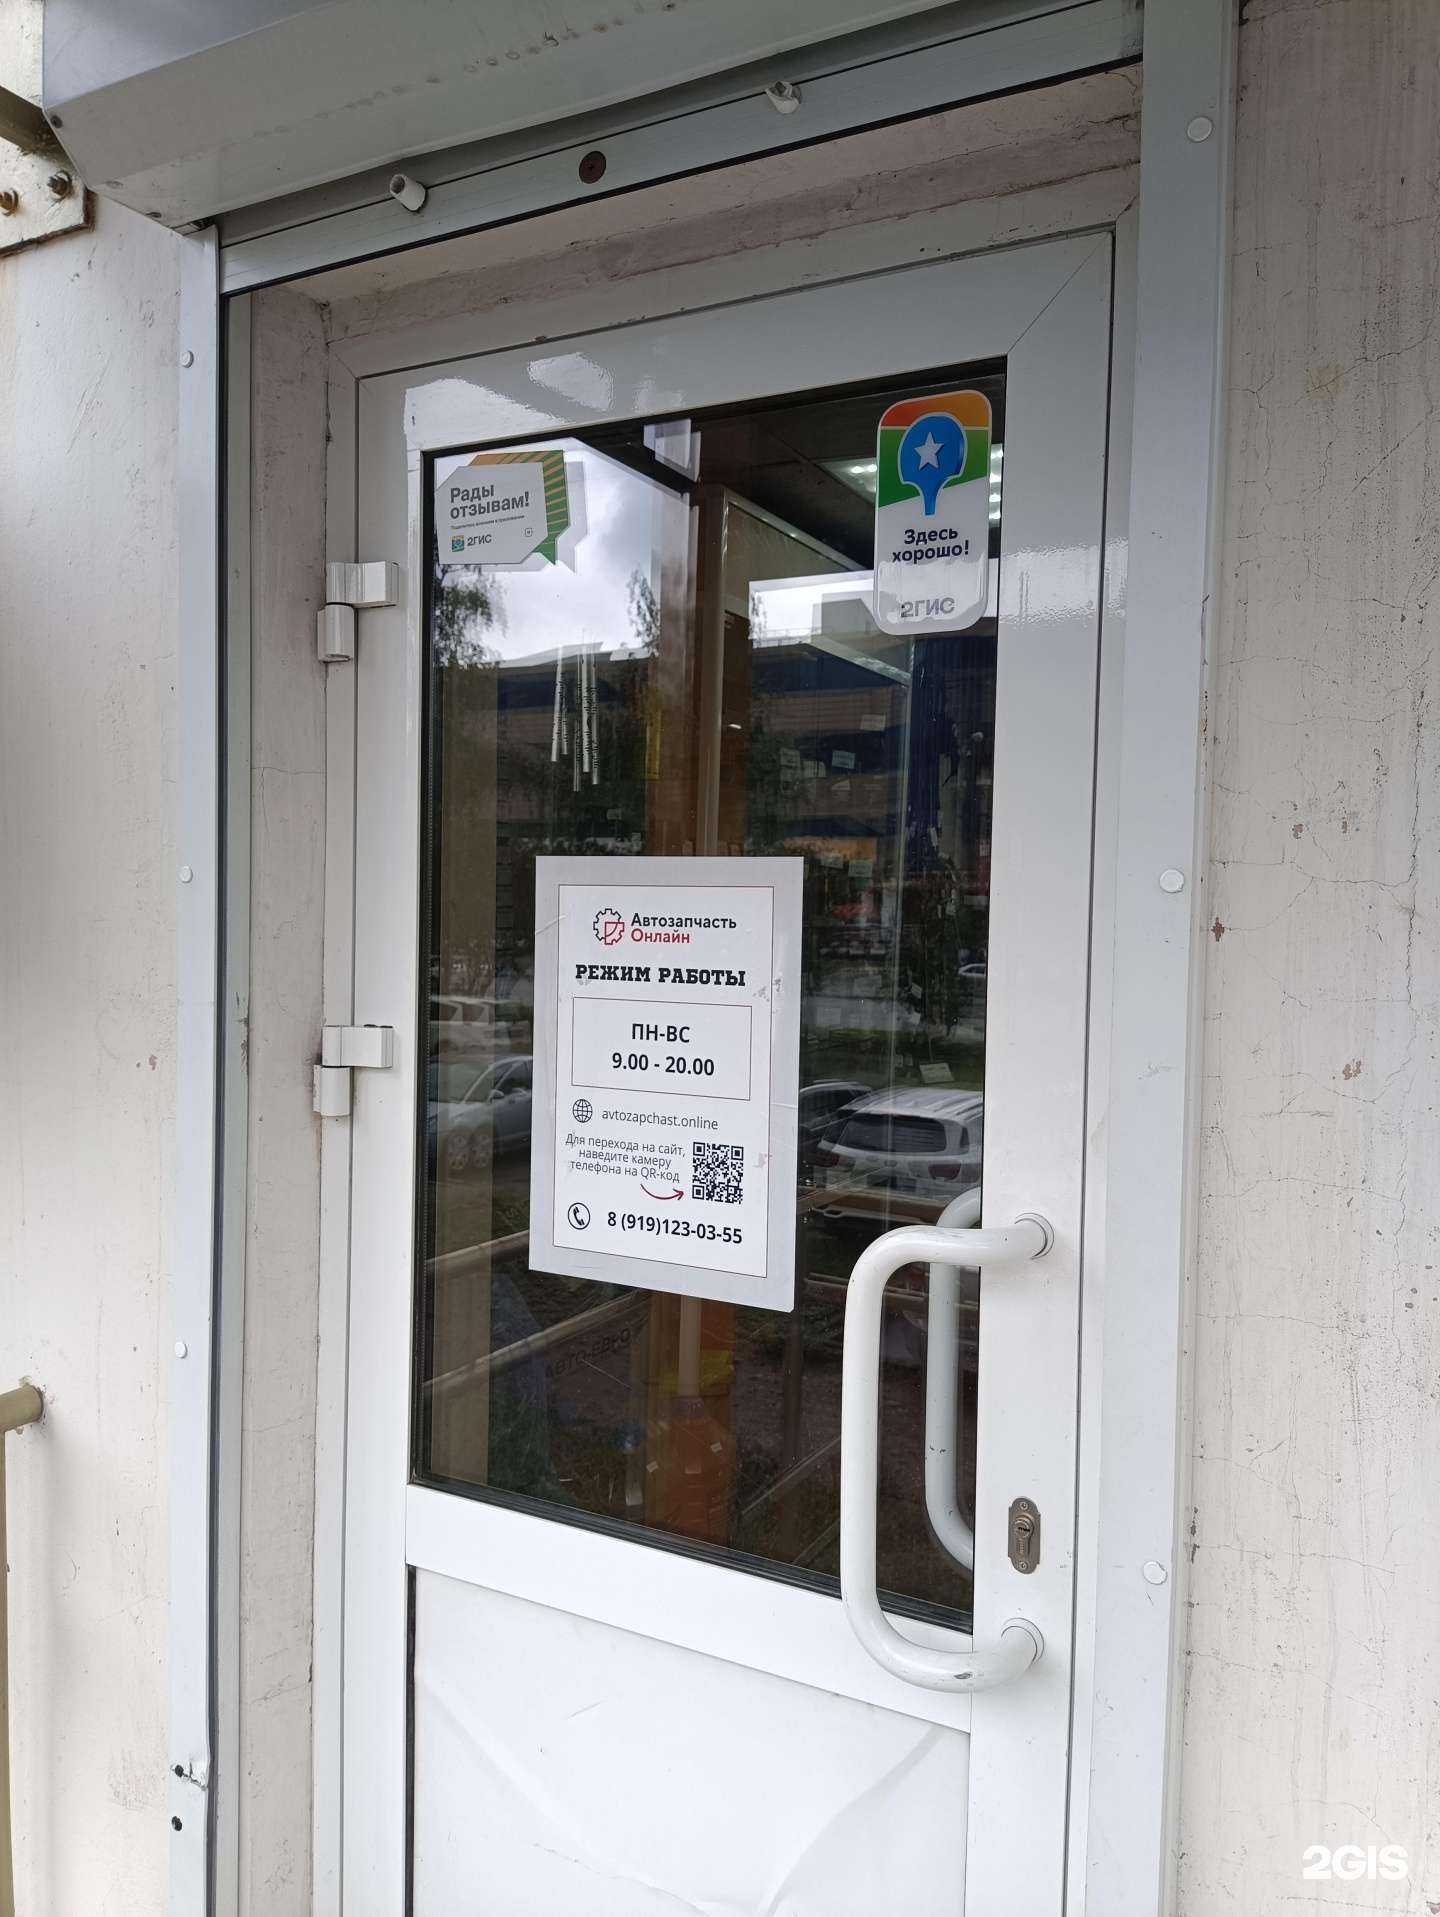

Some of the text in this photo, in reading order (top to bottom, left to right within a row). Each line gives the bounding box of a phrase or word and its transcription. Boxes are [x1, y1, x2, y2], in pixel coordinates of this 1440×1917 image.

[450, 484, 494, 503] Рады
[450, 491, 530, 519] отзывам!
[467, 534, 493, 546] 2ГИС
[904, 528, 959, 545] Здесь
[892, 540, 970, 565] хорошо!
[900, 597, 956, 618] 2ГИС
[631, 913, 737, 929] Автозапчасть
[631, 928, 691, 944] Онлайн
[575, 964, 746, 987] РЕЖИМ РАБОТЫ
[631, 1023, 690, 1043] ПН-ВС
[611, 1052, 649, 1071] 9.00
[664, 1056, 715, 1076] 20.00
[601, 1109, 719, 1130] avtozapchast.online
[565, 1134, 687, 1157] Для перехода на сайт,
[578, 1149, 672, 1169] наведите камеру
[570, 1161, 680, 1183] телефона на QR-код
[607, 1211, 743, 1245] 8 (919)123-03-55
